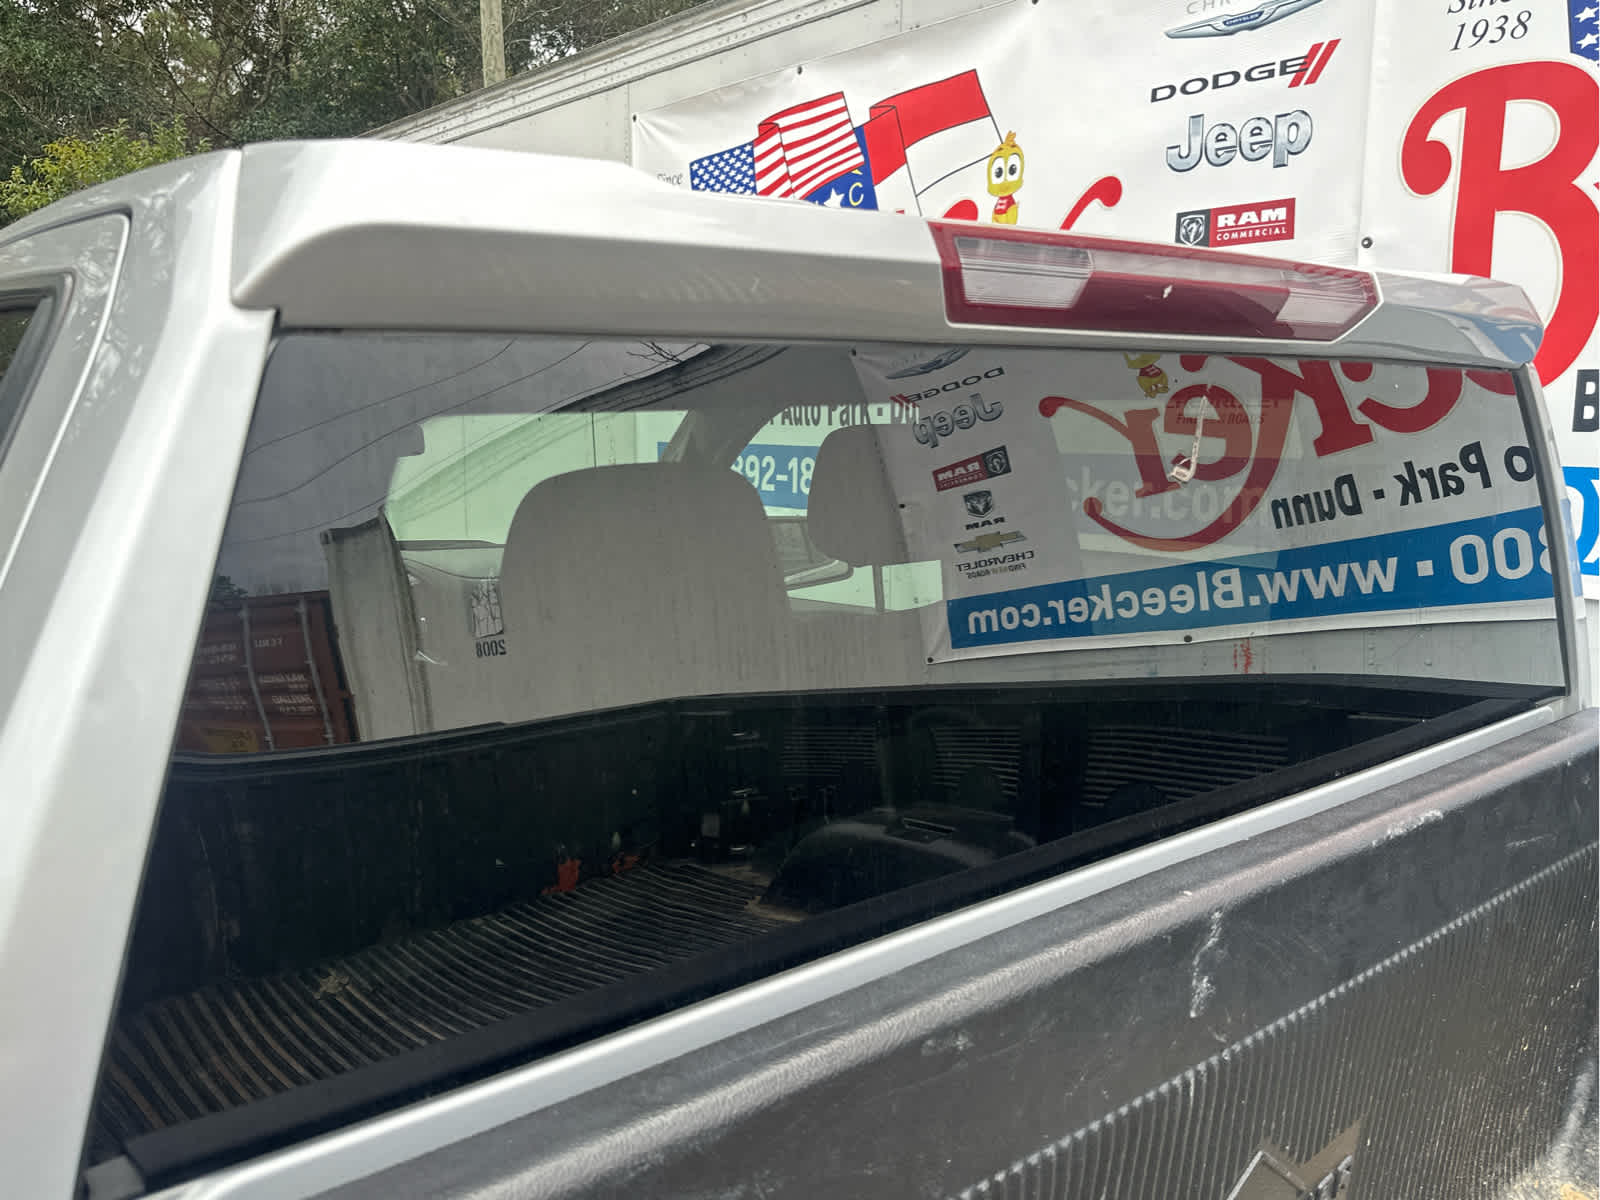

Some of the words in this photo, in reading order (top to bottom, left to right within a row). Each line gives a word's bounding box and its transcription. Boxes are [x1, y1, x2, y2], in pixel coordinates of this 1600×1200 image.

[1450, 9, 1532, 51] 1938
[1150, 55, 1310, 103] DODGE
[1166, 109, 1313, 173] Jeep
[1216, 226, 1288, 241] COMMERCIAL
[1217, 206, 1288, 228] RAM
